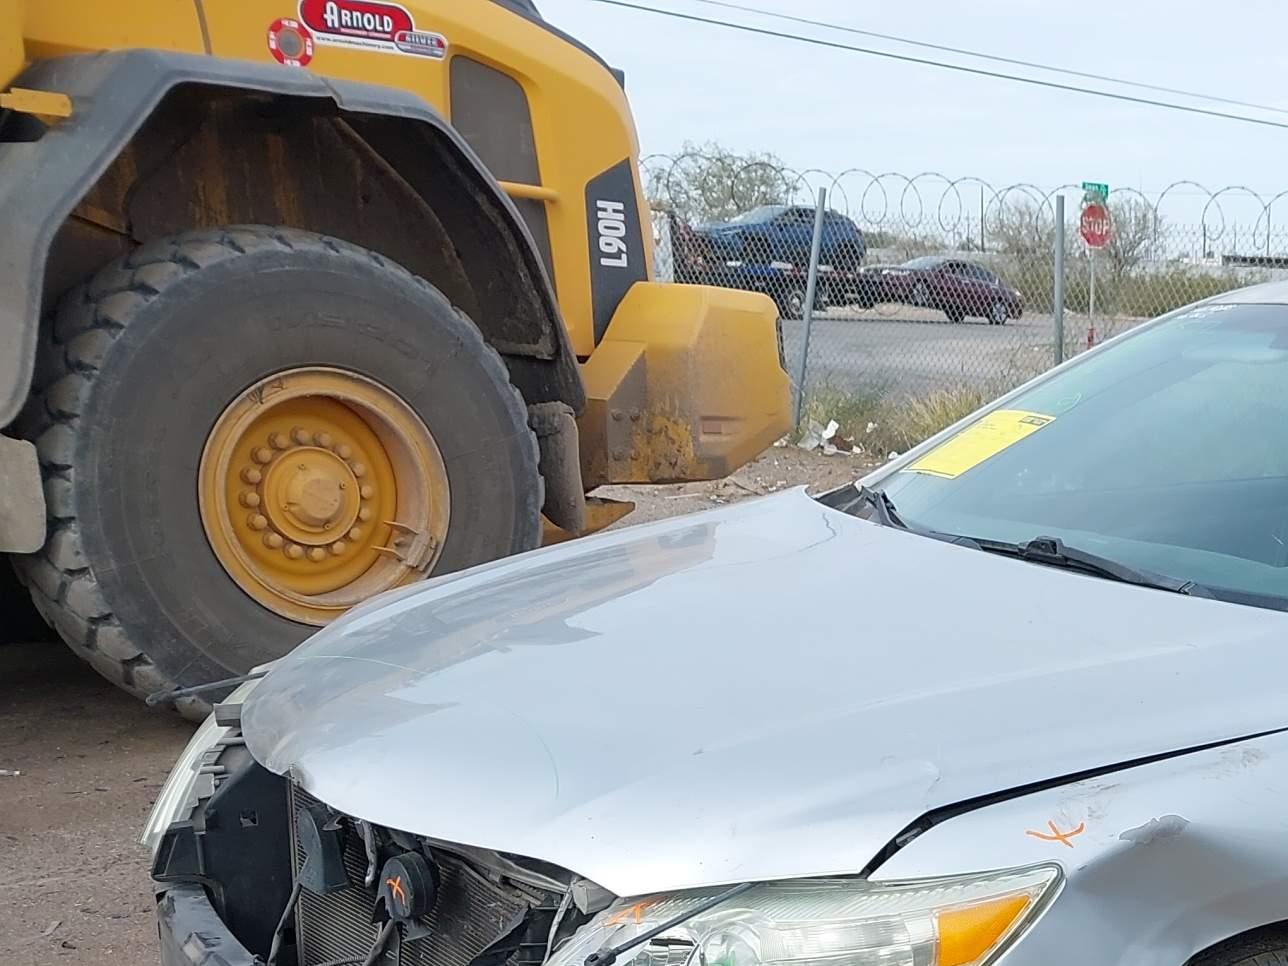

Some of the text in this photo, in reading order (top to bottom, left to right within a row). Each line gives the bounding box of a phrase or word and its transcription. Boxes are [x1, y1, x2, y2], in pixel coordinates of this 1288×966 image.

[323, 1, 393, 32] ARNOLD
[596, 199, 628, 268] L90H
[1082, 215, 1110, 236] STOP
